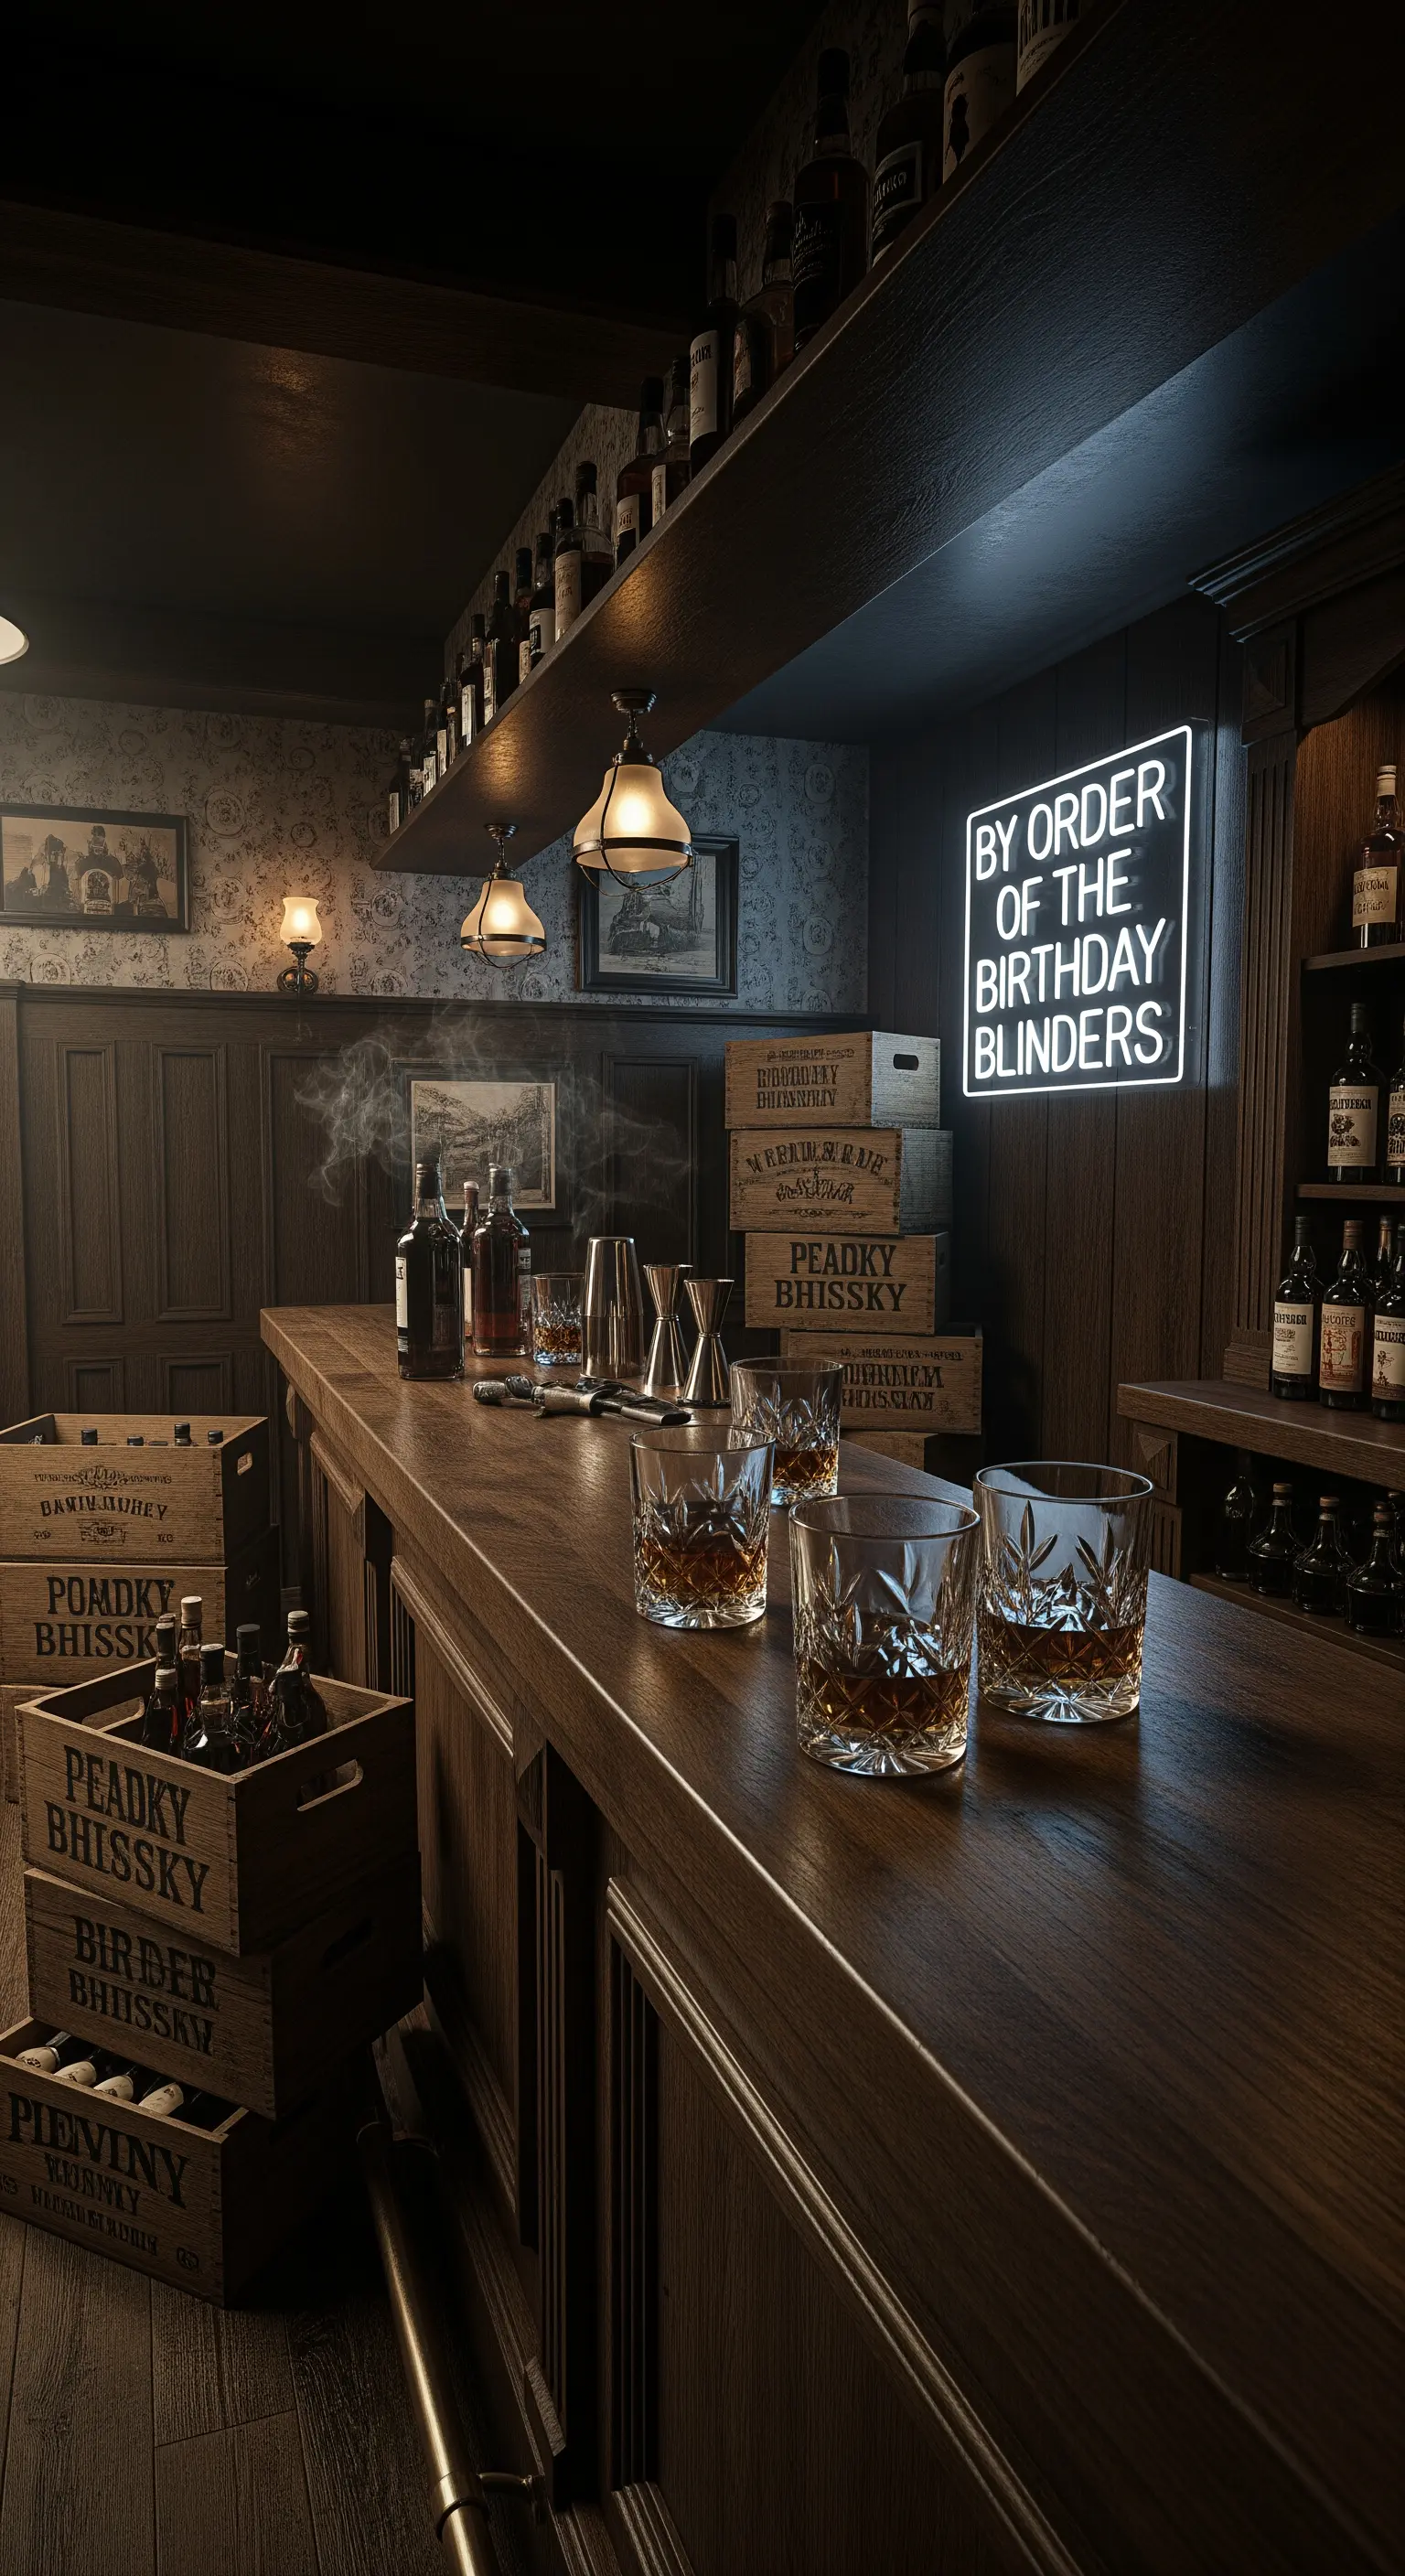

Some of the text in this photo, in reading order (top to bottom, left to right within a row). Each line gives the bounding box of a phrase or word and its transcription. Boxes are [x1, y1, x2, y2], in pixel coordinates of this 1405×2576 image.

[976, 760, 1166, 881] BY ORDER
[996, 848, 1132, 940] OF THE
[976, 918, 1166, 1013] BIRTHDAY
[975, 1001, 1164, 1079] BLINDERS
[774, 1280, 907, 1312] BHISSKY
[789, 1241, 897, 1277] PEADKY
[33, 1622, 157, 1658] BHISSK
[64, 1744, 190, 1847] PEADKY
[44, 1800, 210, 1914] BHISSKY
